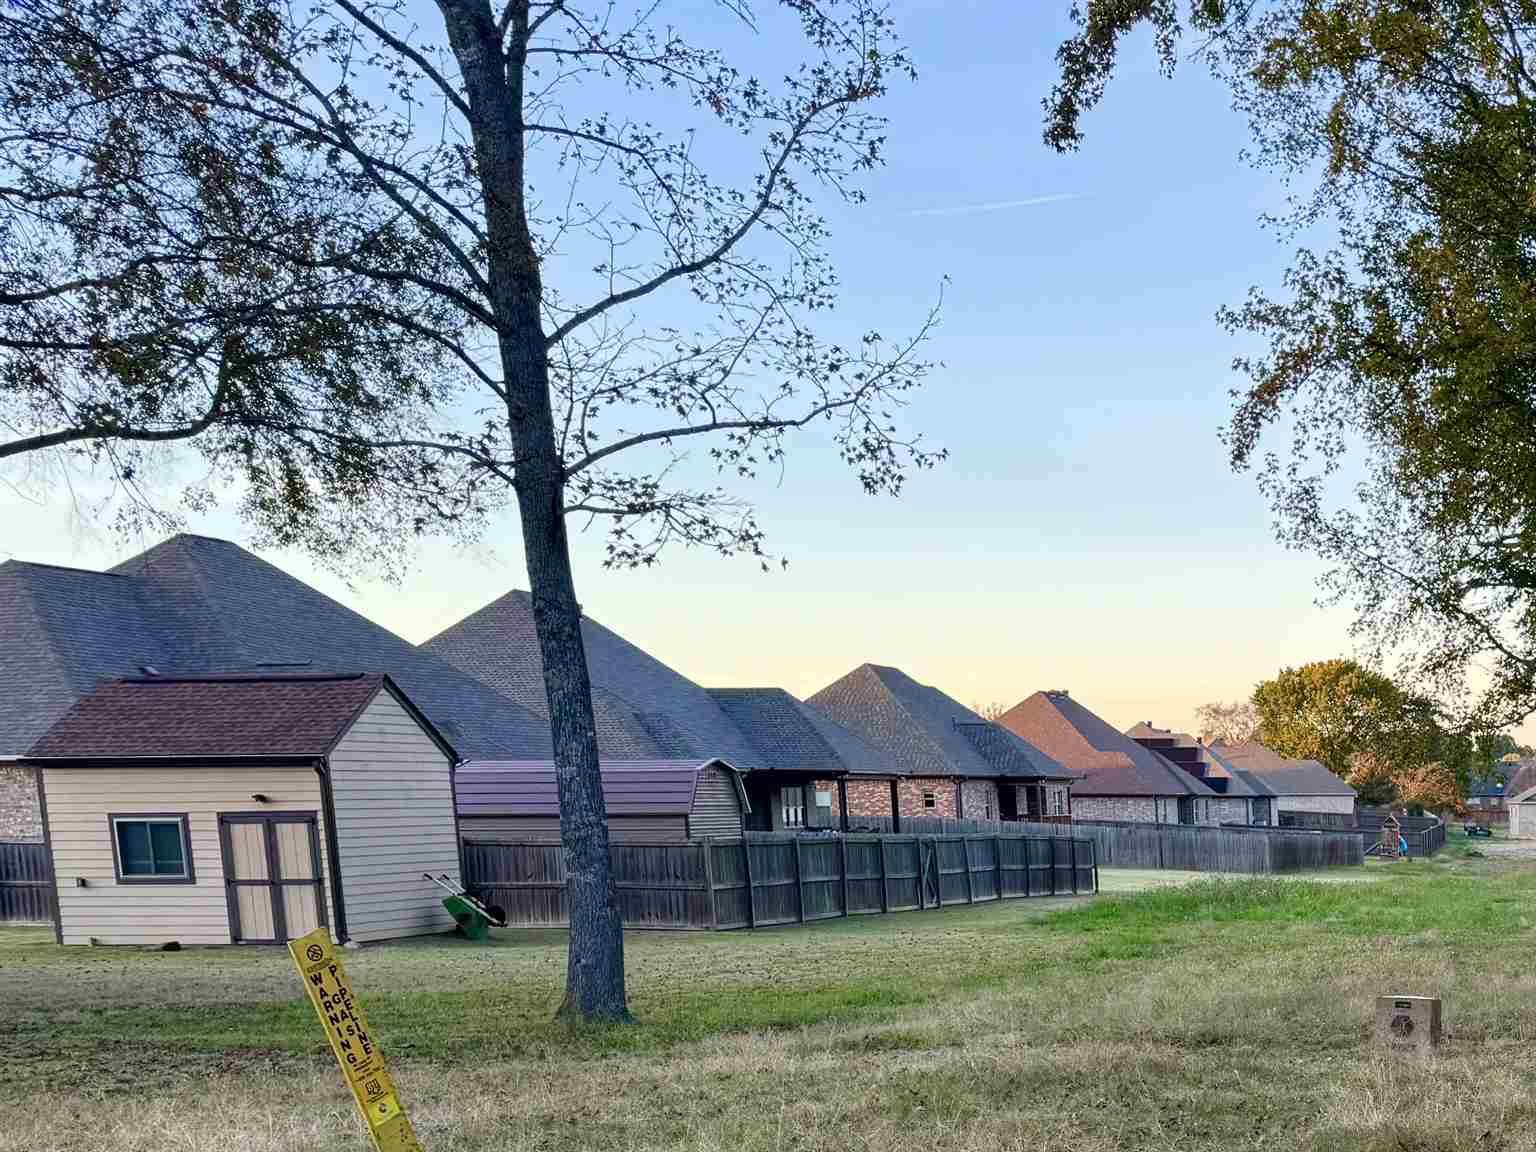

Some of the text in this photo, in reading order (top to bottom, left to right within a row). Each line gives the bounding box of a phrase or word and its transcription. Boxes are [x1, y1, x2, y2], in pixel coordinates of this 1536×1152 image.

[310, 972, 357, 1064] WARNING
[328, 964, 373, 1055] PIPELINE
[332, 993, 355, 1036] GAS
